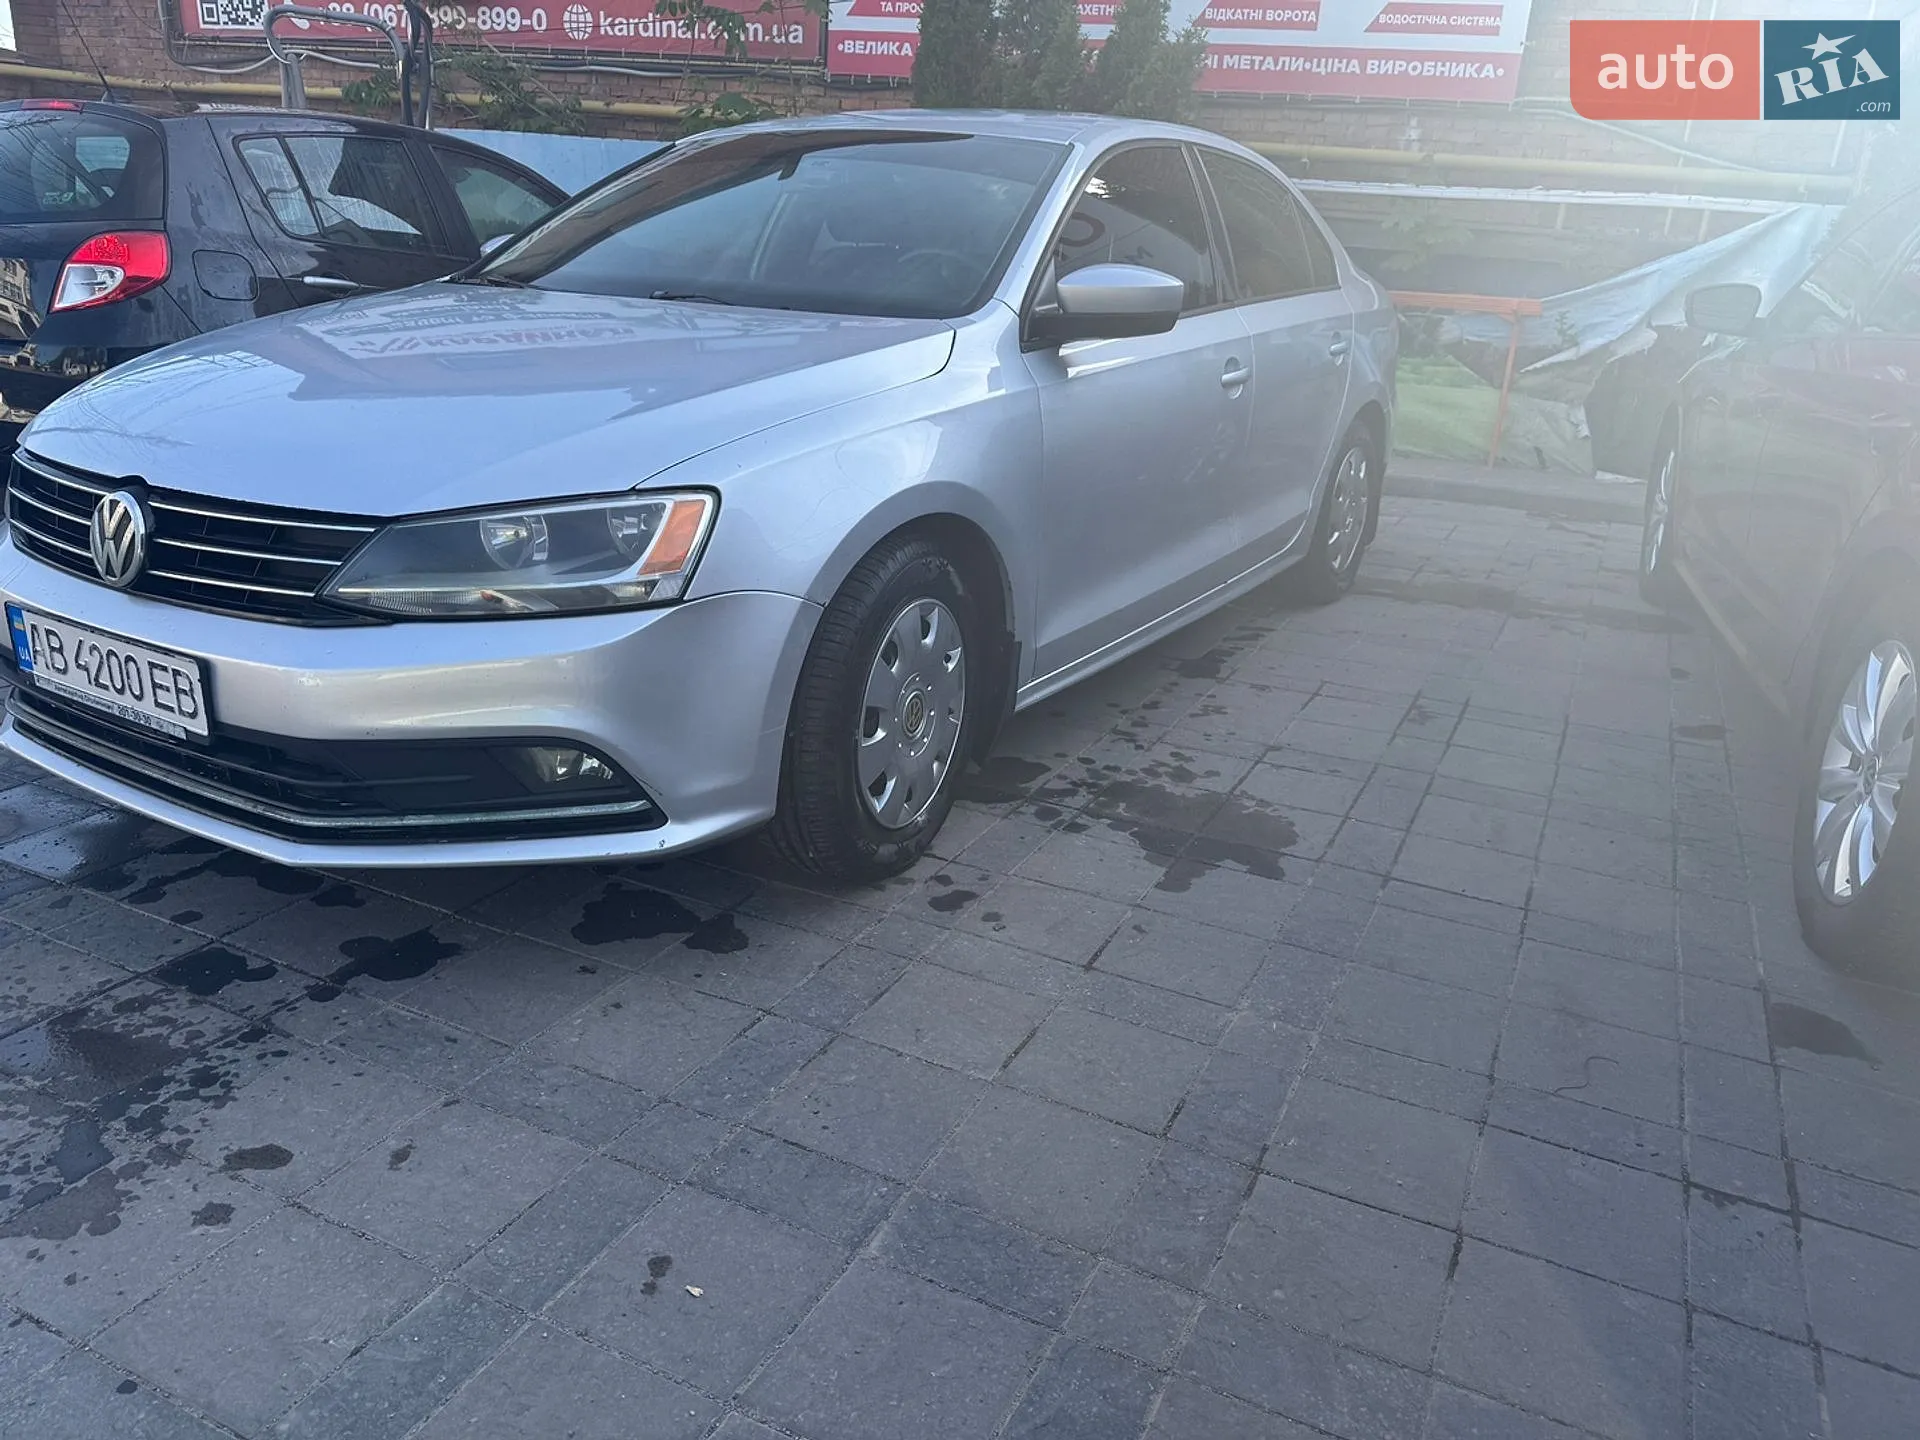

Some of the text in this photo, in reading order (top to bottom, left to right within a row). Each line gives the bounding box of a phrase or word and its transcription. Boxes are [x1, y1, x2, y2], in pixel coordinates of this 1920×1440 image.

[880, 2, 893, 12] ТА
[1205, 8, 1317, 22] ВІДКАТНІ ВОРОТА
[1378, 14, 1502, 27] ВОДОСТІЧНА СИСТЕМА
[599, 10, 804, 44] kardinal.cm.ua
[18, 645, 31, 661] UA
[30, 622, 68, 675] AB
[74, 637, 144, 702] 4200
[147, 659, 199, 720] EB
